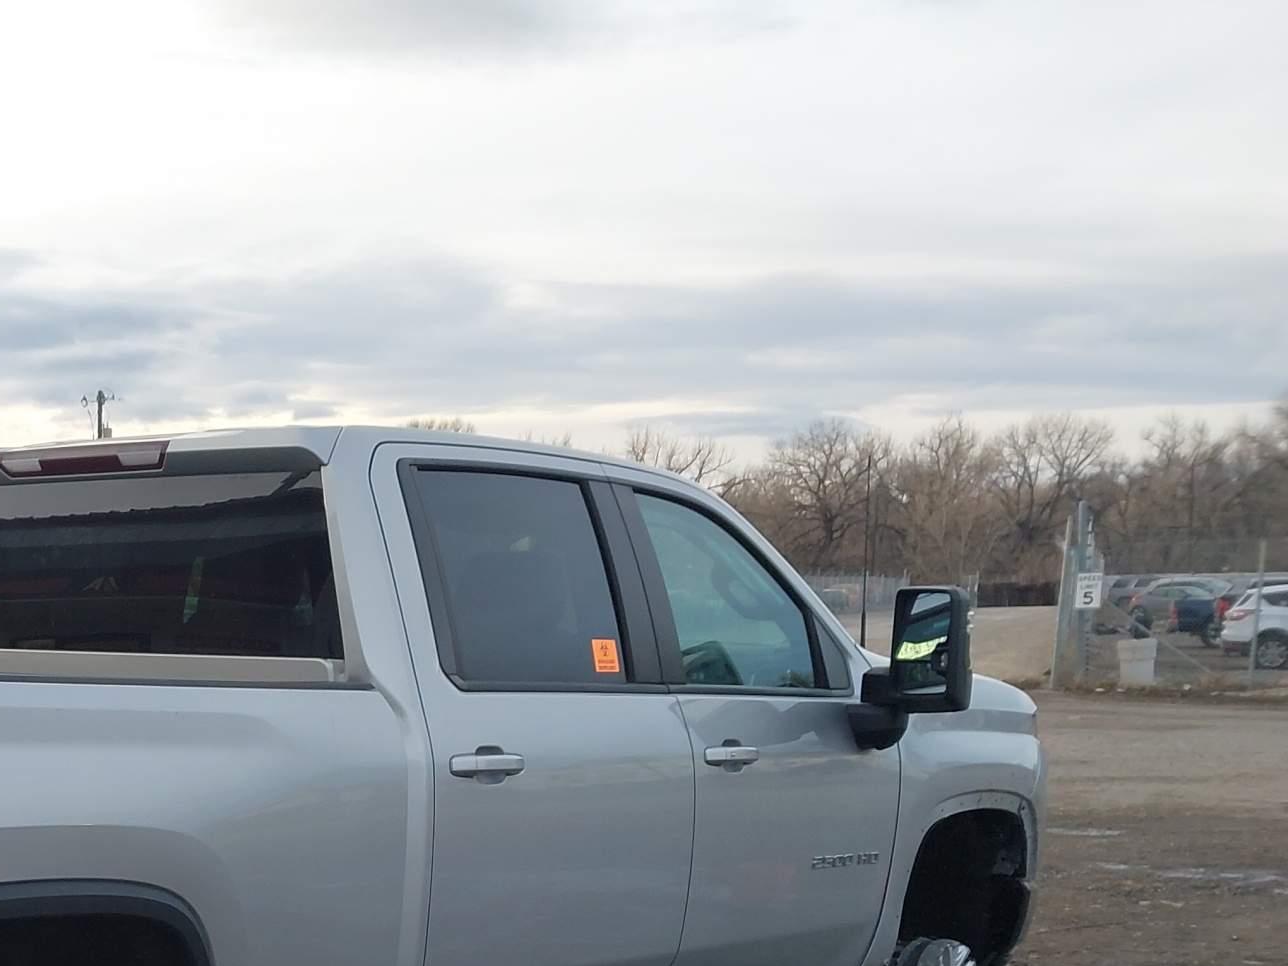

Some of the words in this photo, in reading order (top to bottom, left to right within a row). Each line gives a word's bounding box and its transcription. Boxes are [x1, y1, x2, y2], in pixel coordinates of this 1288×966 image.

[1082, 591, 1094, 605] 5
[812, 853, 854, 869] 2500
[856, 851, 880, 865] HD
